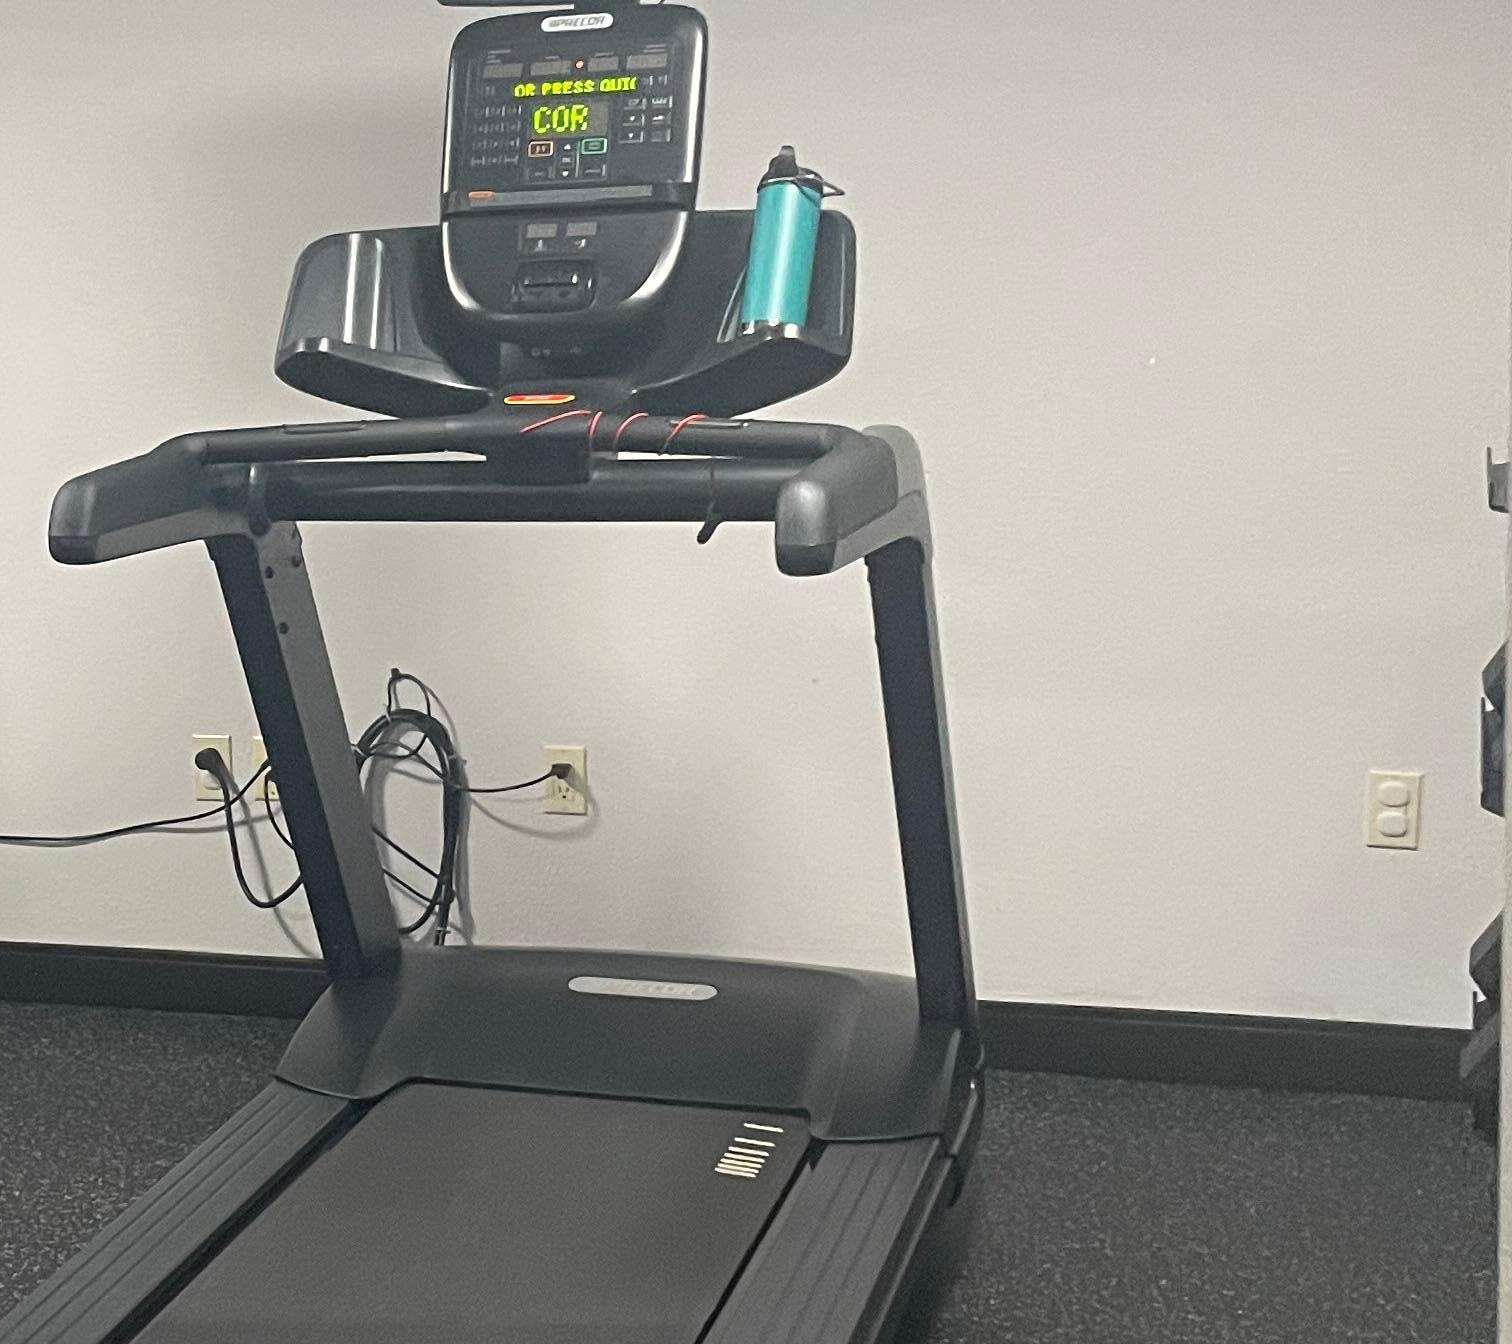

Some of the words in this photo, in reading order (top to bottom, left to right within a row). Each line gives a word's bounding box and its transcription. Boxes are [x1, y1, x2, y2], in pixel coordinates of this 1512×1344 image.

[514, 82, 536, 97] OR
[541, 80, 595, 96] PRESS
[533, 104, 589, 134] COR
